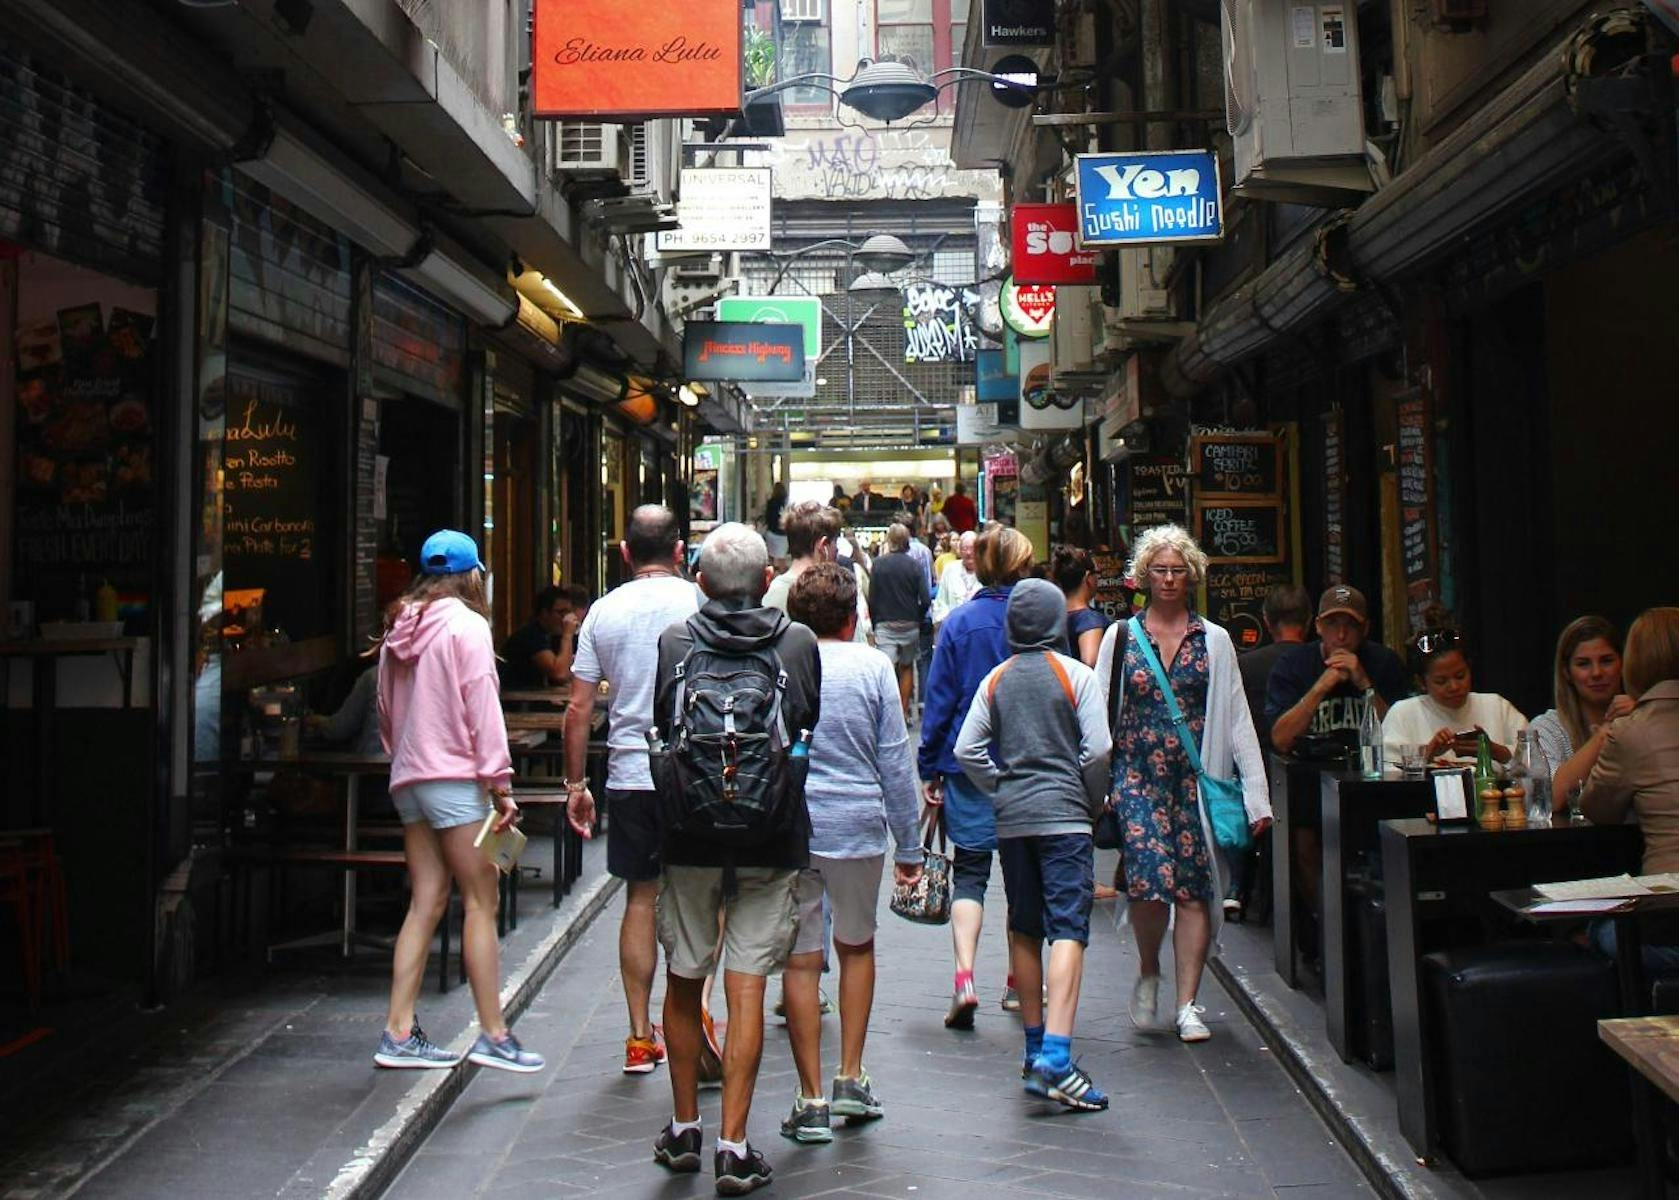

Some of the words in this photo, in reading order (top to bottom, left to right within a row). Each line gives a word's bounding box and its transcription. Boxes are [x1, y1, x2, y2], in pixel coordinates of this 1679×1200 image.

[990, 25, 1048, 37] Hawkers
[554, 37, 648, 65] Eliana
[652, 36, 723, 64] Lulu
[682, 173, 765, 185] UNIVERSAL
[1093, 164, 1200, 200] Yen
[1085, 202, 1140, 236] Sushi
[1027, 222, 1048, 232] the
[731, 233, 765, 244] 2997
[1205, 508, 1234, 522] ICED
[1213, 518, 1257, 533] COFFEE
